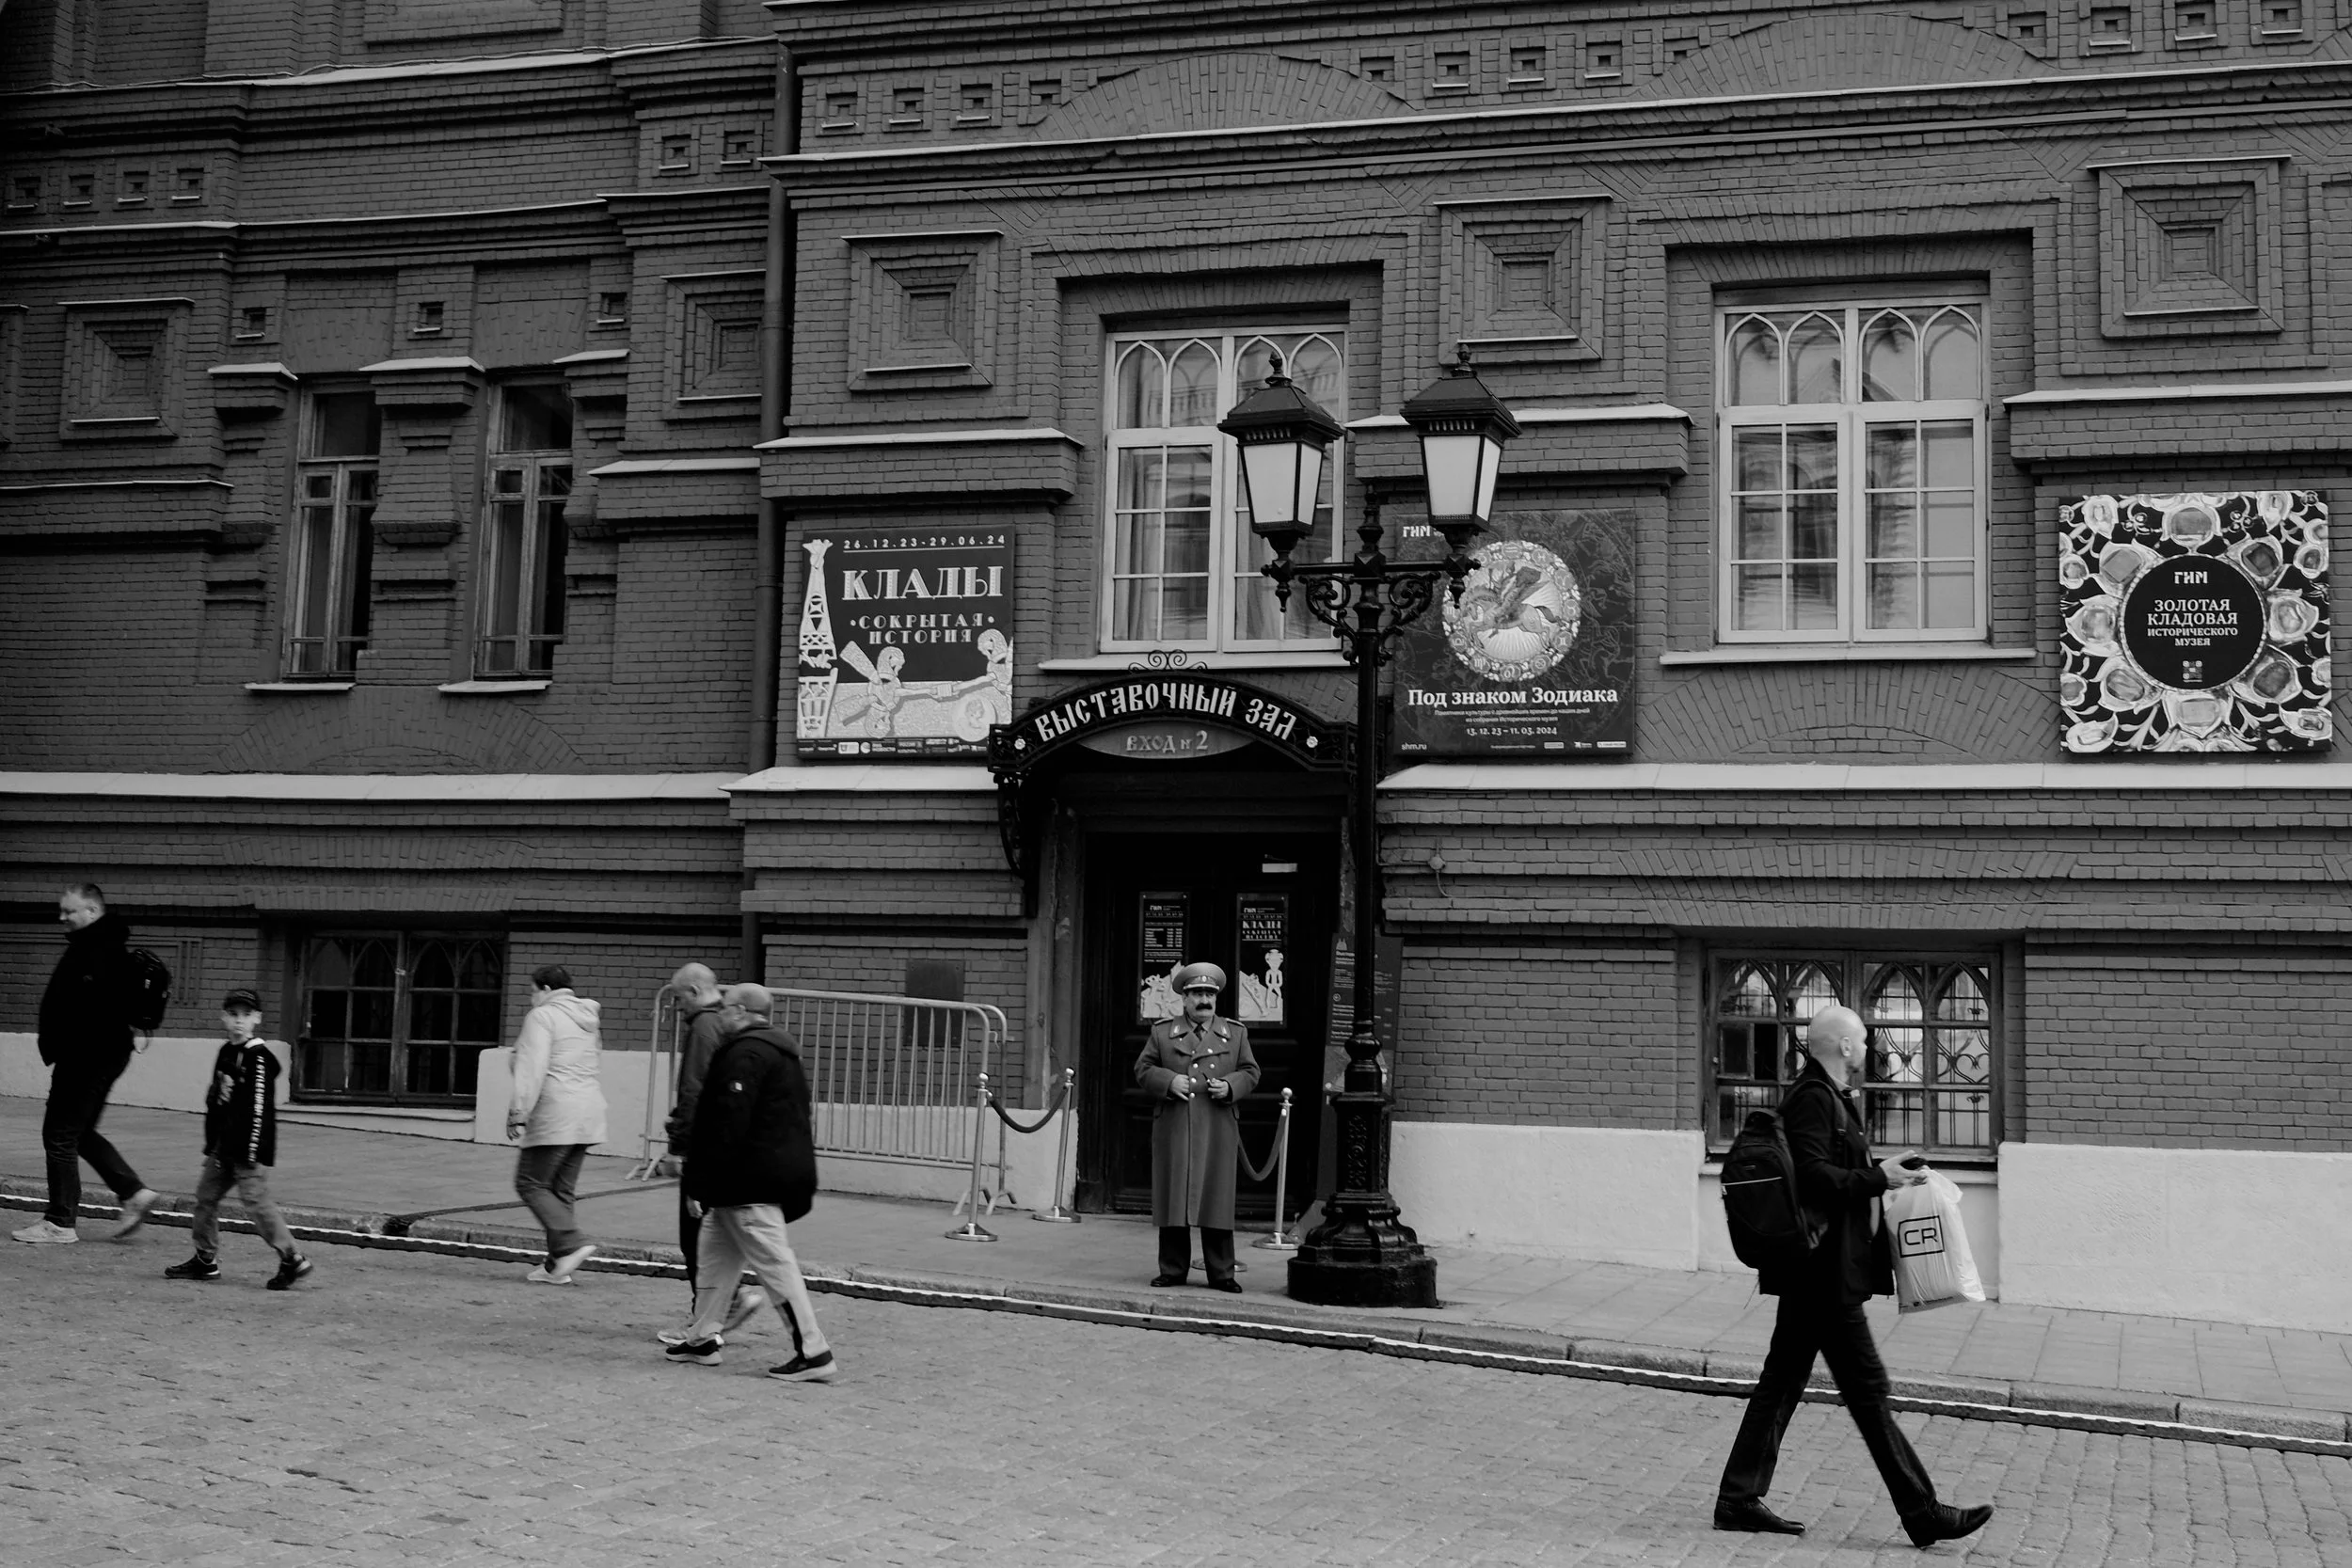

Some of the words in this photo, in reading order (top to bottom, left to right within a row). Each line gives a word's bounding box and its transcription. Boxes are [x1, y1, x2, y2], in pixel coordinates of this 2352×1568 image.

[841, 565, 1004, 600] КЛАДЫ
[2153, 598, 2231, 612] ЗОЛОТАЯ
[2147, 612, 2238, 627] КЛАДОВАЯ
[869, 629, 973, 644] ИСТОРИЯ
[2147, 627, 2238, 637] ИСТОРИЧЕСКОГО
[2174, 638, 2211, 646] МУЗЕЯ
[1408, 689, 1448, 708] Под
[1452, 689, 1527, 705] знаком
[1532, 687, 1619, 706] Зодиака
[1035, 682, 1237, 742] ВЫСТАВОЧНЫЙ
[1245, 698, 1297, 740] ЗАЛ
[1535, 726, 1557, 736] 2024
[1126, 735, 1176, 753] ВХОД
[1196, 730, 1208, 751] 2
[1401, 742, 1427, 751] shm.ru
[1904, 1227, 1938, 1245] CR
